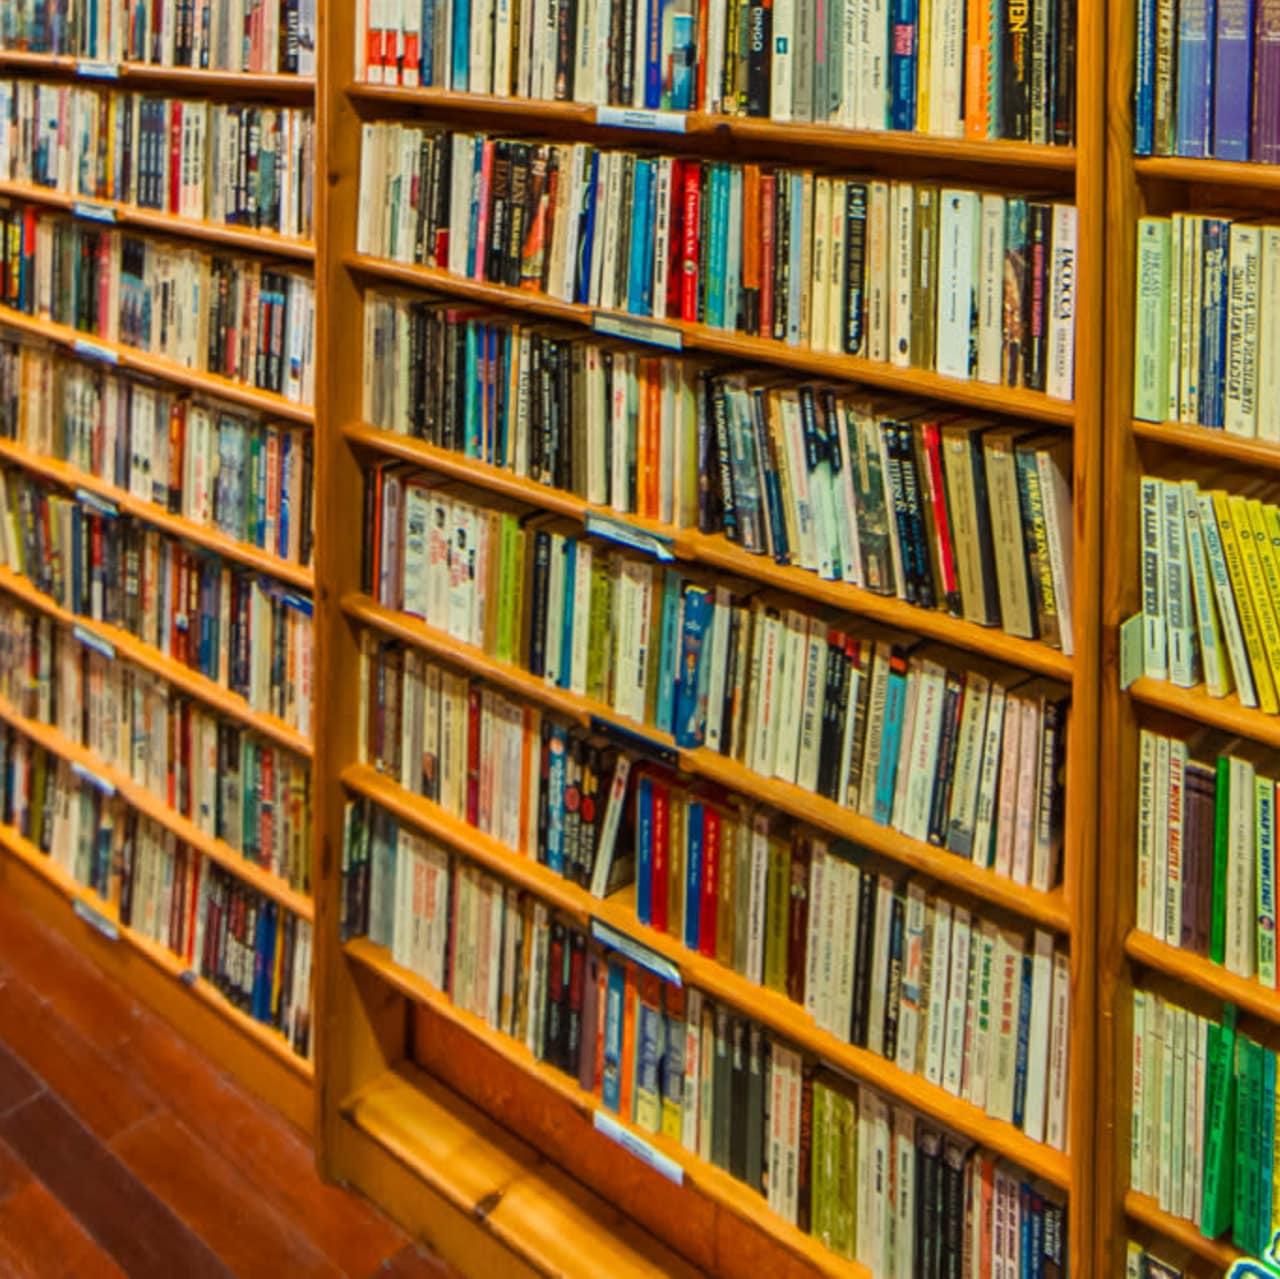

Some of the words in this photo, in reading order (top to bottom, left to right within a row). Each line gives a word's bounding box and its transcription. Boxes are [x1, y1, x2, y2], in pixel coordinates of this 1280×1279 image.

[751, 7, 763, 52] DINGO
[1059, 247, 1074, 321] IACOCCA
[714, 399, 729, 446] THUNDER
[719, 451, 731, 462] IN
[720, 465, 734, 511] AMERICA
[1144, 483, 1159, 505] TIM
[1144, 508, 1159, 548] ALLEN
[1168, 517, 1182, 555] ALLEN
[1169, 827, 1180, 863] SALUTE
